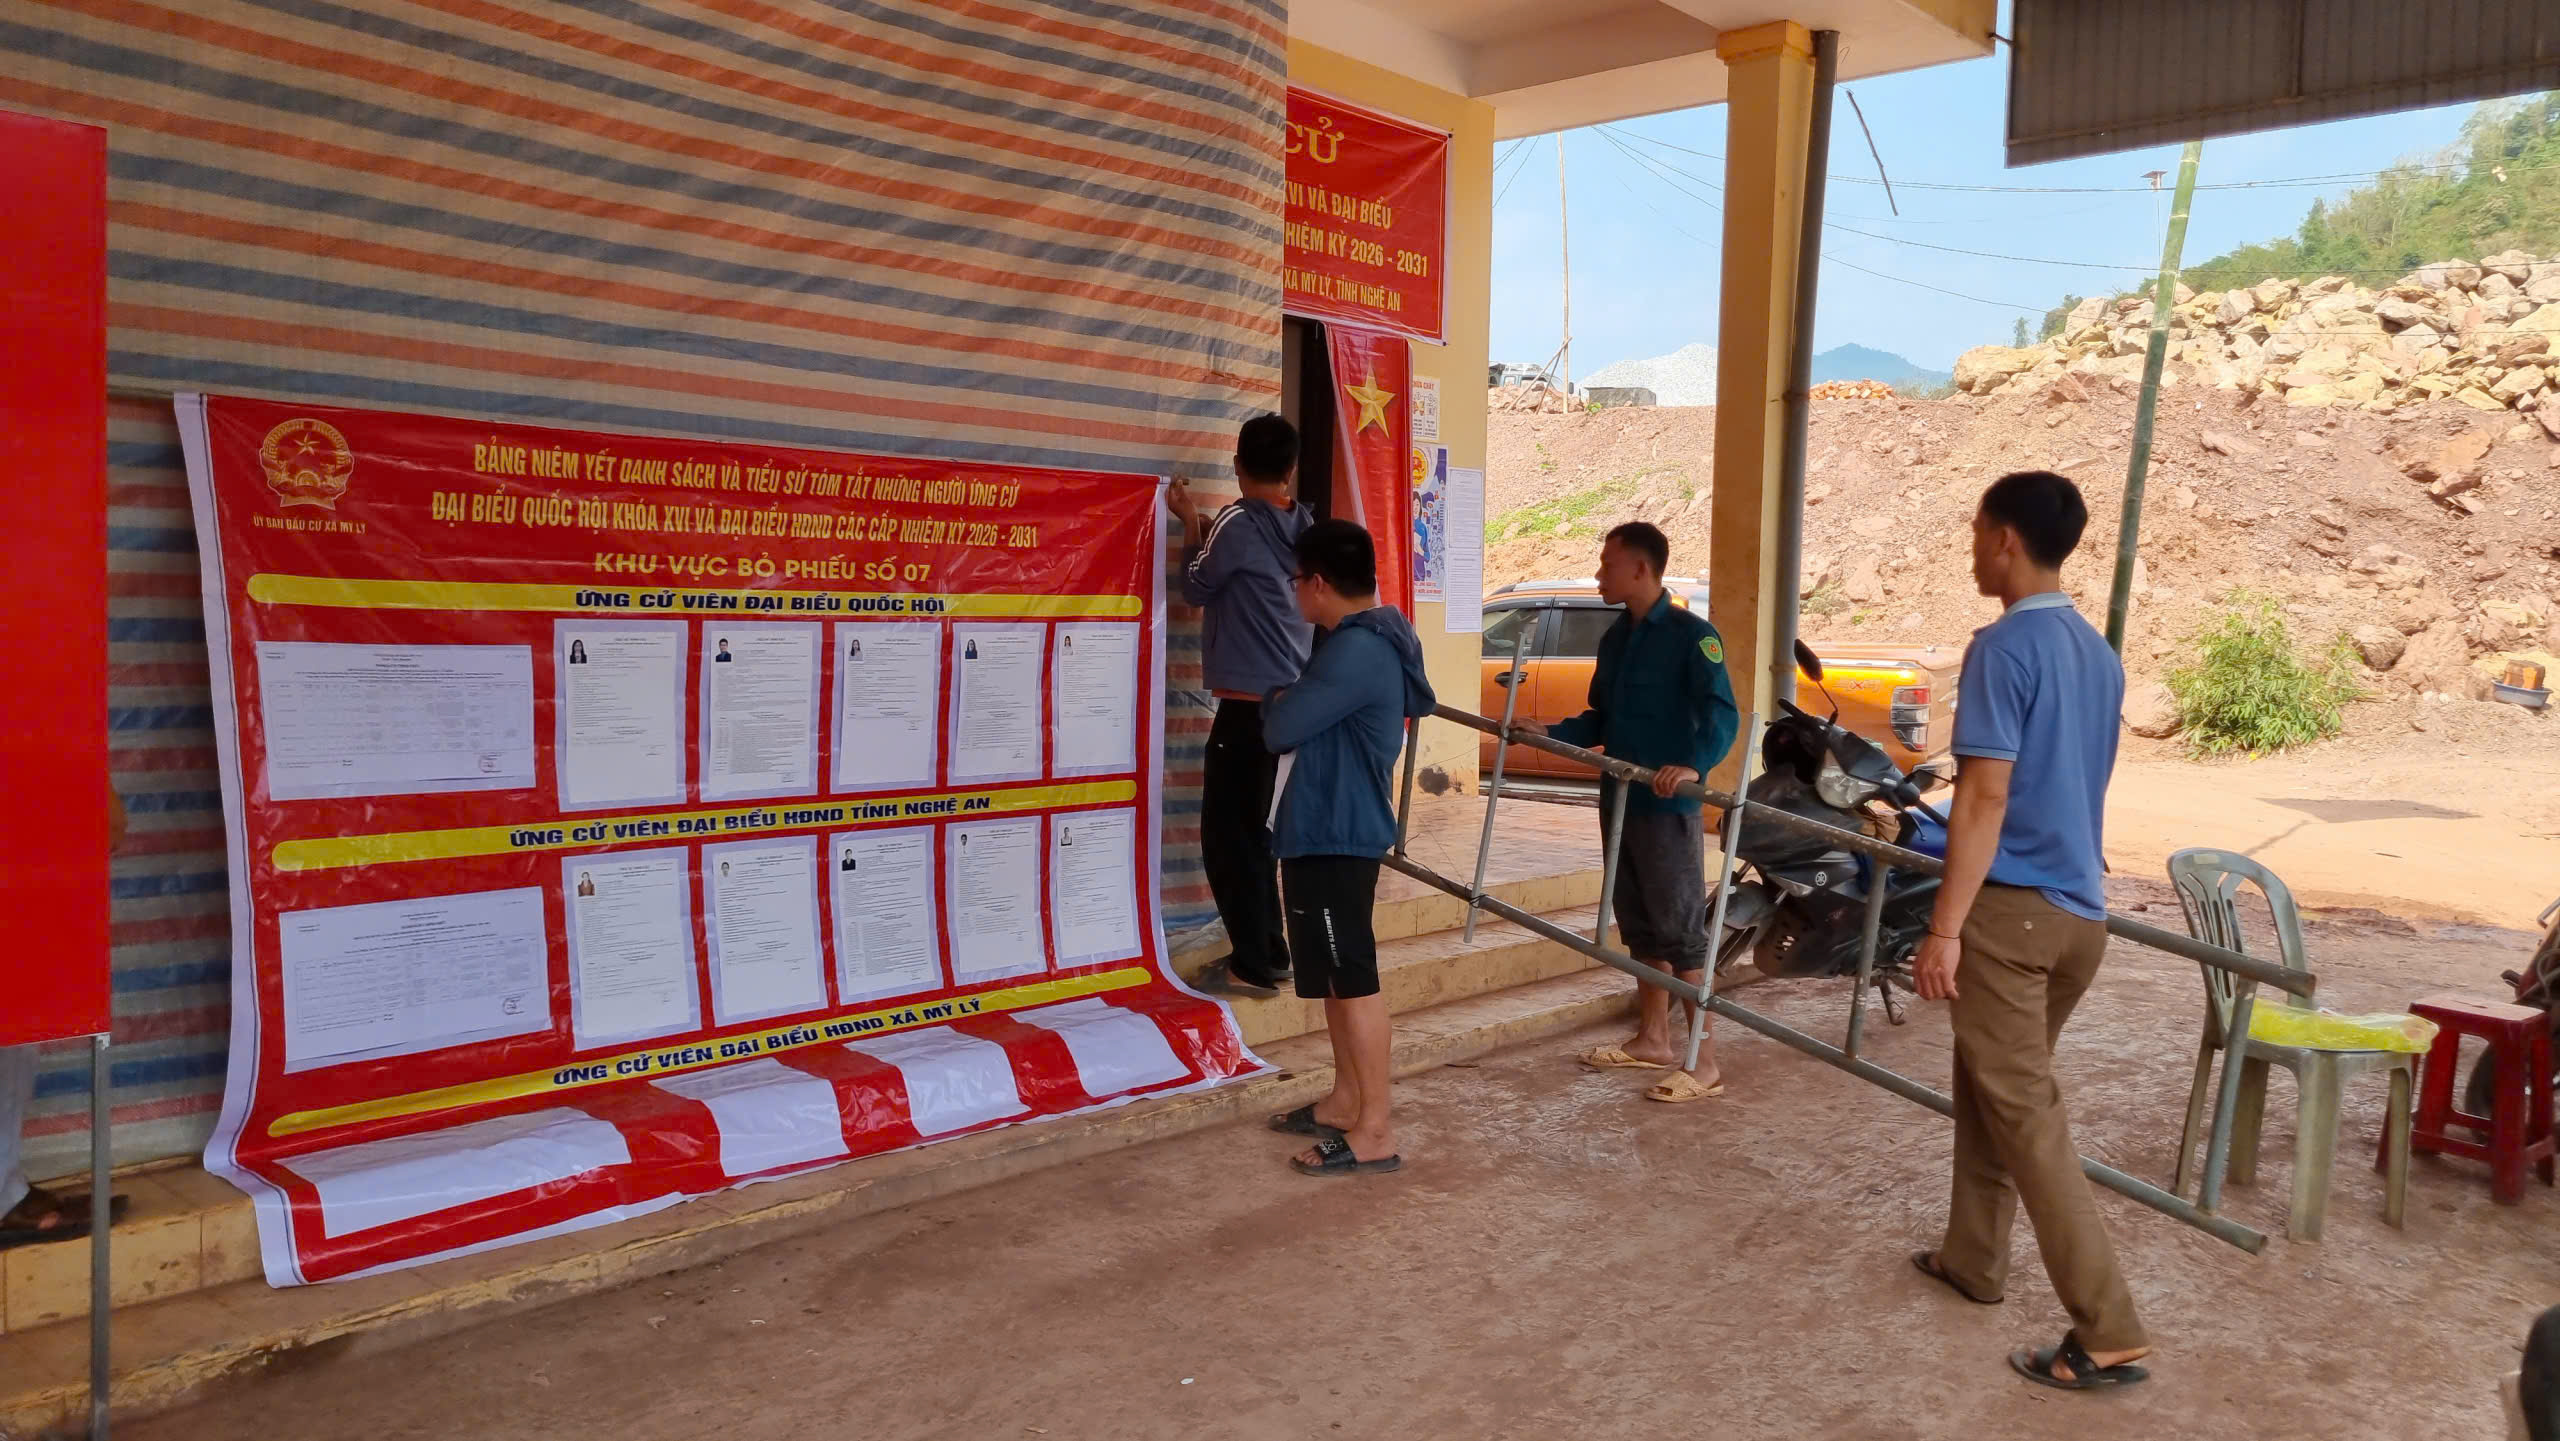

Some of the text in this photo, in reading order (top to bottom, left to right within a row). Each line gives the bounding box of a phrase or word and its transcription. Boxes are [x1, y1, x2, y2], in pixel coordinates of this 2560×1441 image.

[1308, 184, 1328, 213] VÀ
[1332, 192, 1356, 224] ĐẠI
[1360, 196, 1392, 229] BIỂU
[1285, 221, 1324, 255] HIỆM
[1328, 229, 1346, 257] KỲ
[1351, 238, 1384, 267] 2026
[1397, 249, 1428, 277] 2031
[1336, 274, 1358, 303] TỈNH
[1360, 285, 1385, 313] NGHỆ
[1387, 291, 1400, 311] AN
[474, 435, 1020, 508] BẢNG NIÊM YẾT DANH SÁCH VÀ TIỂU SỬ TÓM TẮT NHỮNG NGƯỜI ỨNG CỬ
[266, 517, 283, 529] BAN
[432, 491, 466, 527] ĐẠI
[472, 483, 516, 525] BIỂU
[522, 489, 572, 529] QUỐC
[578, 496, 608, 535] HỘI
[612, 498, 659, 531] KHÓA
[663, 505, 690, 533] XVI
[695, 502, 716, 534] VÀ
[719, 508, 748, 541] ĐẠI
[751, 502, 788, 537] BIỂU
[790, 513, 833, 540] HĐND
[836, 511, 865, 541] CÁC
[868, 510, 897, 542] CẤP
[900, 515, 945, 549] NHIỆM
[946, 516, 966, 544] KỲ
[966, 523, 998, 546] 2026
[1008, 525, 1038, 548] 2031
[594, 552, 931, 582] KHU VỰC BỎ PHIẾU SỐ 07
[576, 589, 945, 614] ỨNG CỬ VIÊN ĐẠI BIỂU QUỐC HỘI
[510, 796, 991, 847] ỨNG CỬ VIÊN ĐẠI BIỂU HĐND TỈNH NGHỆ AN
[553, 998, 981, 1086] ỨNG CỬ VIÊN ĐẠI BIỂU HĐND XÃ MỸ LÝ
